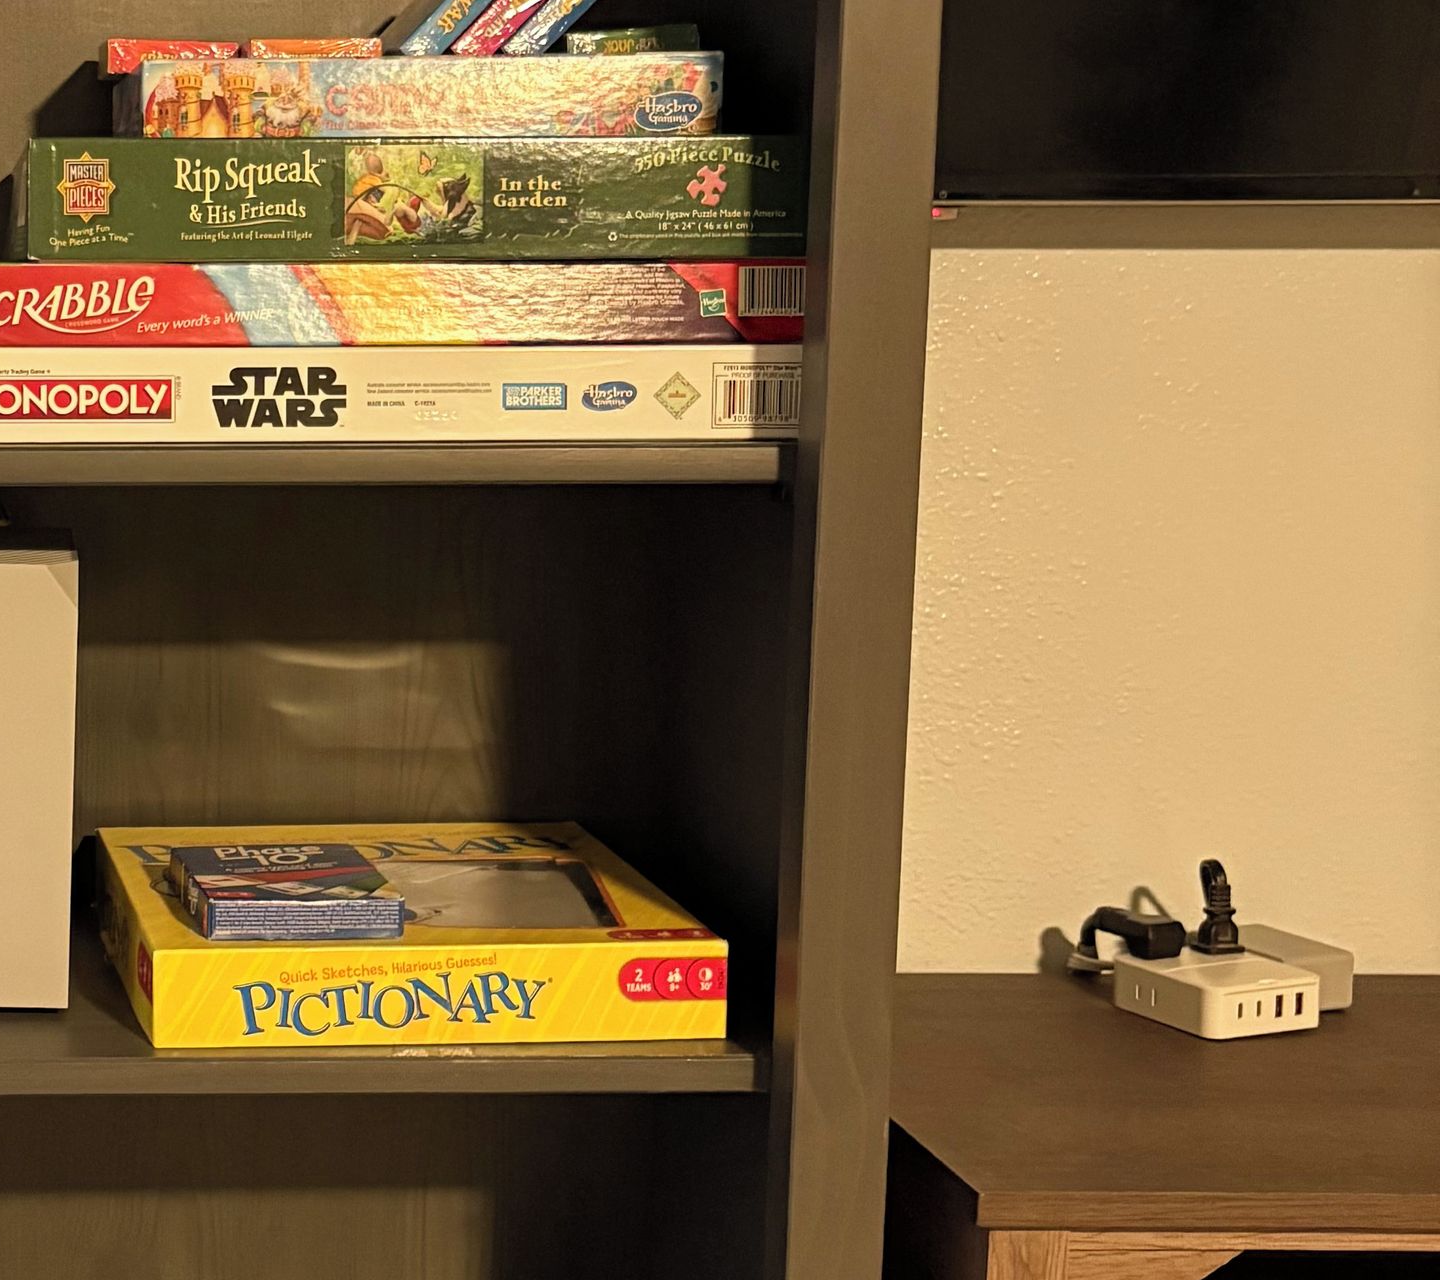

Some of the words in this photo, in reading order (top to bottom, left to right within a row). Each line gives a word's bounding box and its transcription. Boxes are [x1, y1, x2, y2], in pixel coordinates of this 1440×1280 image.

[638, 96, 698, 114] Hasbro
[648, 112, 688, 126] Gaming
[722, 146, 781, 172] Puzzle
[70, 165, 104, 181] MASTER
[174, 158, 220, 204] Rip
[499, 176, 521, 192] In
[528, 175, 562, 192] the
[70, 186, 104, 207] PIECES
[493, 192, 568, 208] Garden
[189, 203, 203, 223] &
[208, 204, 237, 224] His
[241, 199, 307, 220] Friends
[635, 210, 664, 221] Quality
[666, 210, 690, 221] Jigsaw
[692, 209, 718, 218] Puzzle
[719, 209, 742, 218] Made
[743, 209, 751, 218] in
[753, 209, 787, 218] America
[96, 224, 110, 233] Fun
[673, 223, 680, 231] x
[716, 223, 723, 231] x
[49, 237, 67, 247] One
[69, 236, 90, 247] Piece
[91, 234, 100, 243] at
[109, 232, 129, 244] Time
[180, 232, 216, 243] Featuring
[217, 230, 229, 240] the
[232, 231, 244, 240] Art
[245, 230, 254, 241] of
[255, 230, 286, 240] Leonard
[137, 320, 169, 335] Every
[173, 314, 211, 329] word's
[213, 315, 221, 325] a
[224, 307, 274, 324] WINNER
[211, 366, 347, 396] STAR
[521, 386, 562, 396] PARKER
[584, 385, 633, 401] Hasbro
[506, 396, 562, 407] BROTHERS
[211, 398, 347, 428] WARS
[214, 845, 323, 860] Phase
[257, 853, 308, 866] 10
[279, 969, 318, 985] Quick
[322, 963, 388, 981] Sketches,
[391, 960, 442, 976] Hilarious
[446, 952, 498, 971] Guesses!
[635, 968, 643, 982] 2
[626, 983, 652, 992] TEAMS
[232, 971, 546, 1037] PICTIONARY
